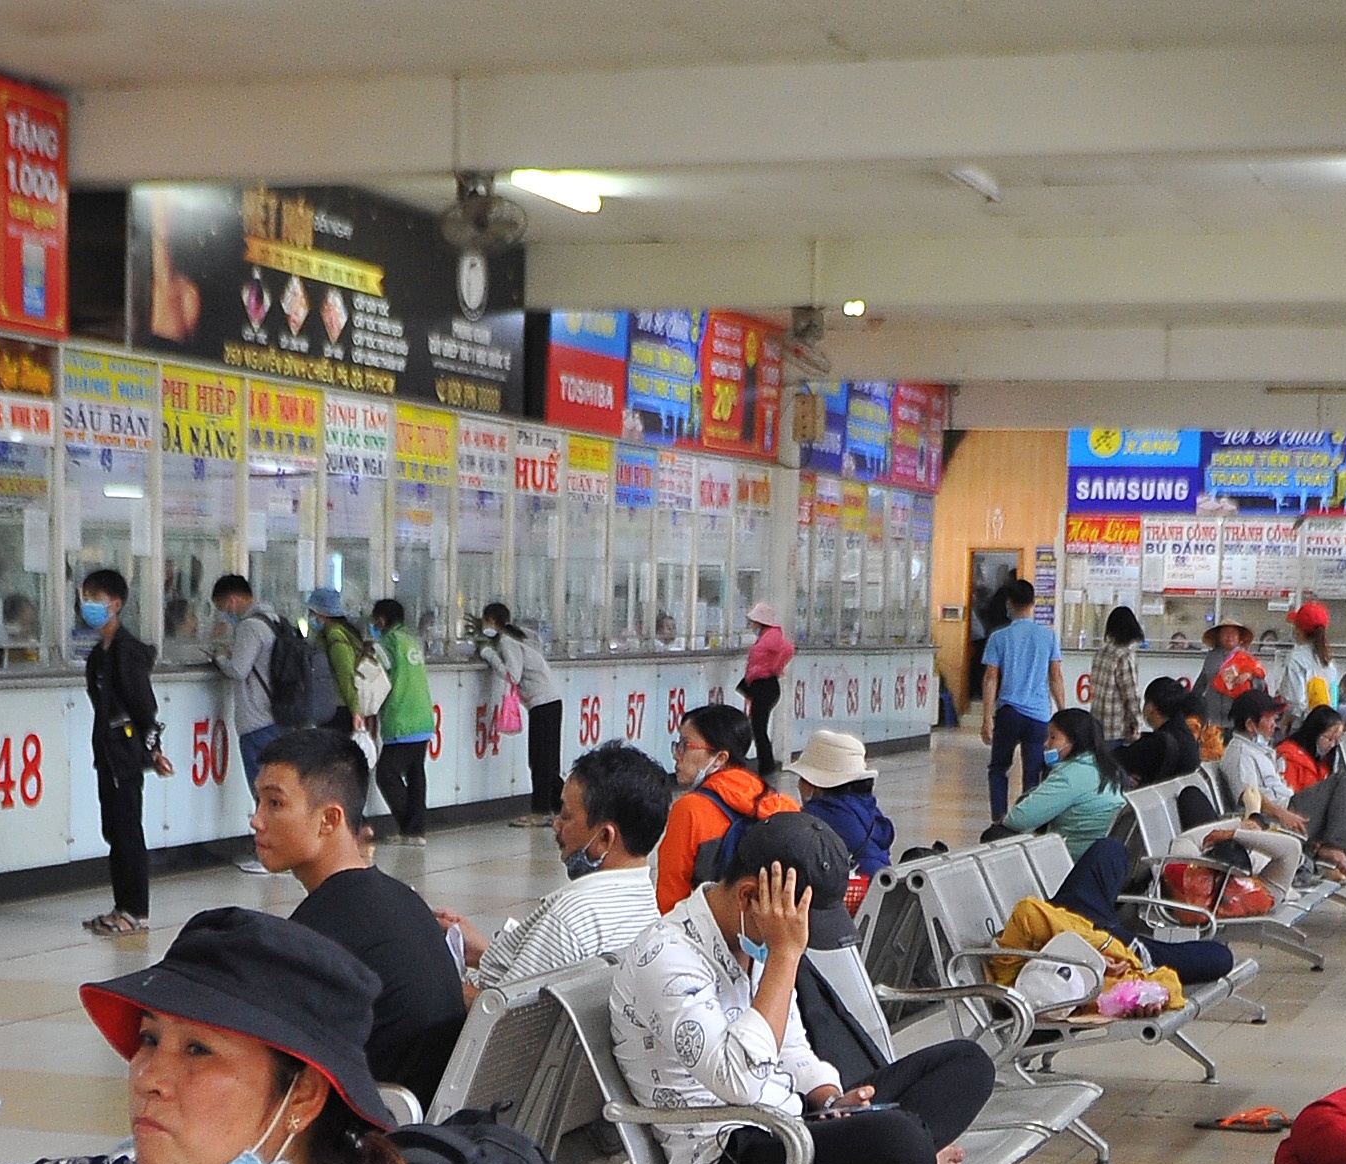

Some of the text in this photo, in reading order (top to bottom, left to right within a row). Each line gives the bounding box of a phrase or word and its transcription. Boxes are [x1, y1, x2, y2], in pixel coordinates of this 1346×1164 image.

[559, 373, 615, 411] TOSHIBA
[515, 449, 560, 494] HUẾ
[1075, 475, 1190, 502] SAMSUNG
[1209, 472, 1249, 487] TRAO
[475, 703, 501, 759] 54
[578, 696, 602, 746] 56
[625, 692, 646, 740] 57
[666, 687, 686, 735] 58
[191, 718, 229, 788] 50
